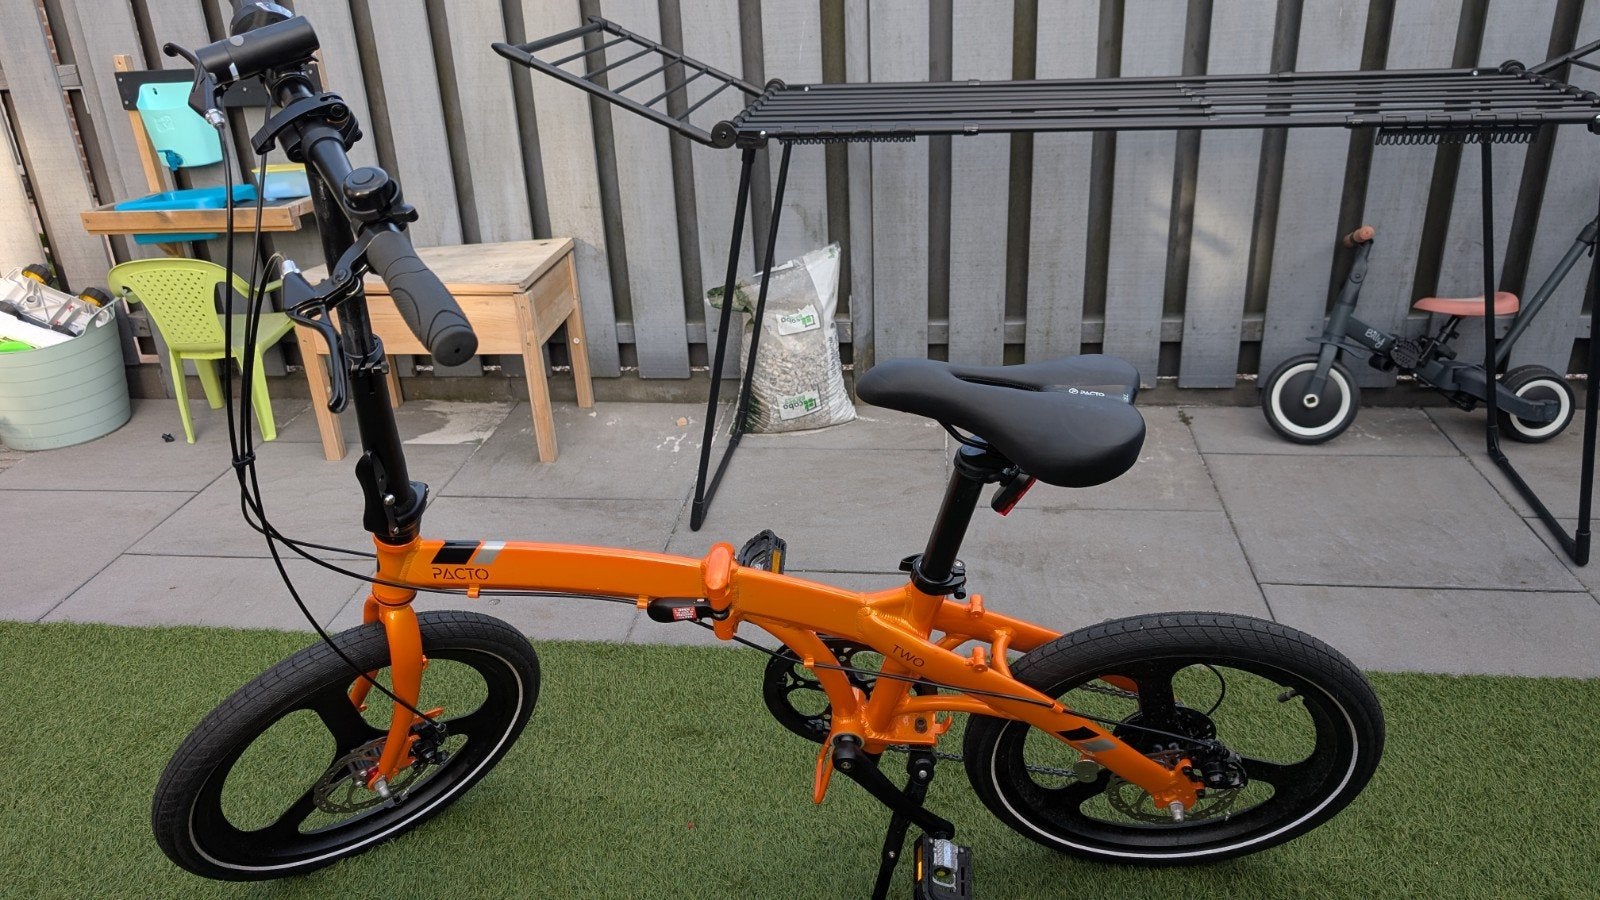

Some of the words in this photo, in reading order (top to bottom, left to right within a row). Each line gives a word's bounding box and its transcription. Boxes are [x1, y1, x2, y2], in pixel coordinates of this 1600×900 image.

[1080, 389, 1105, 397] PACTO
[432, 567, 489, 580] PACTO
[893, 644, 925, 667] TWO
